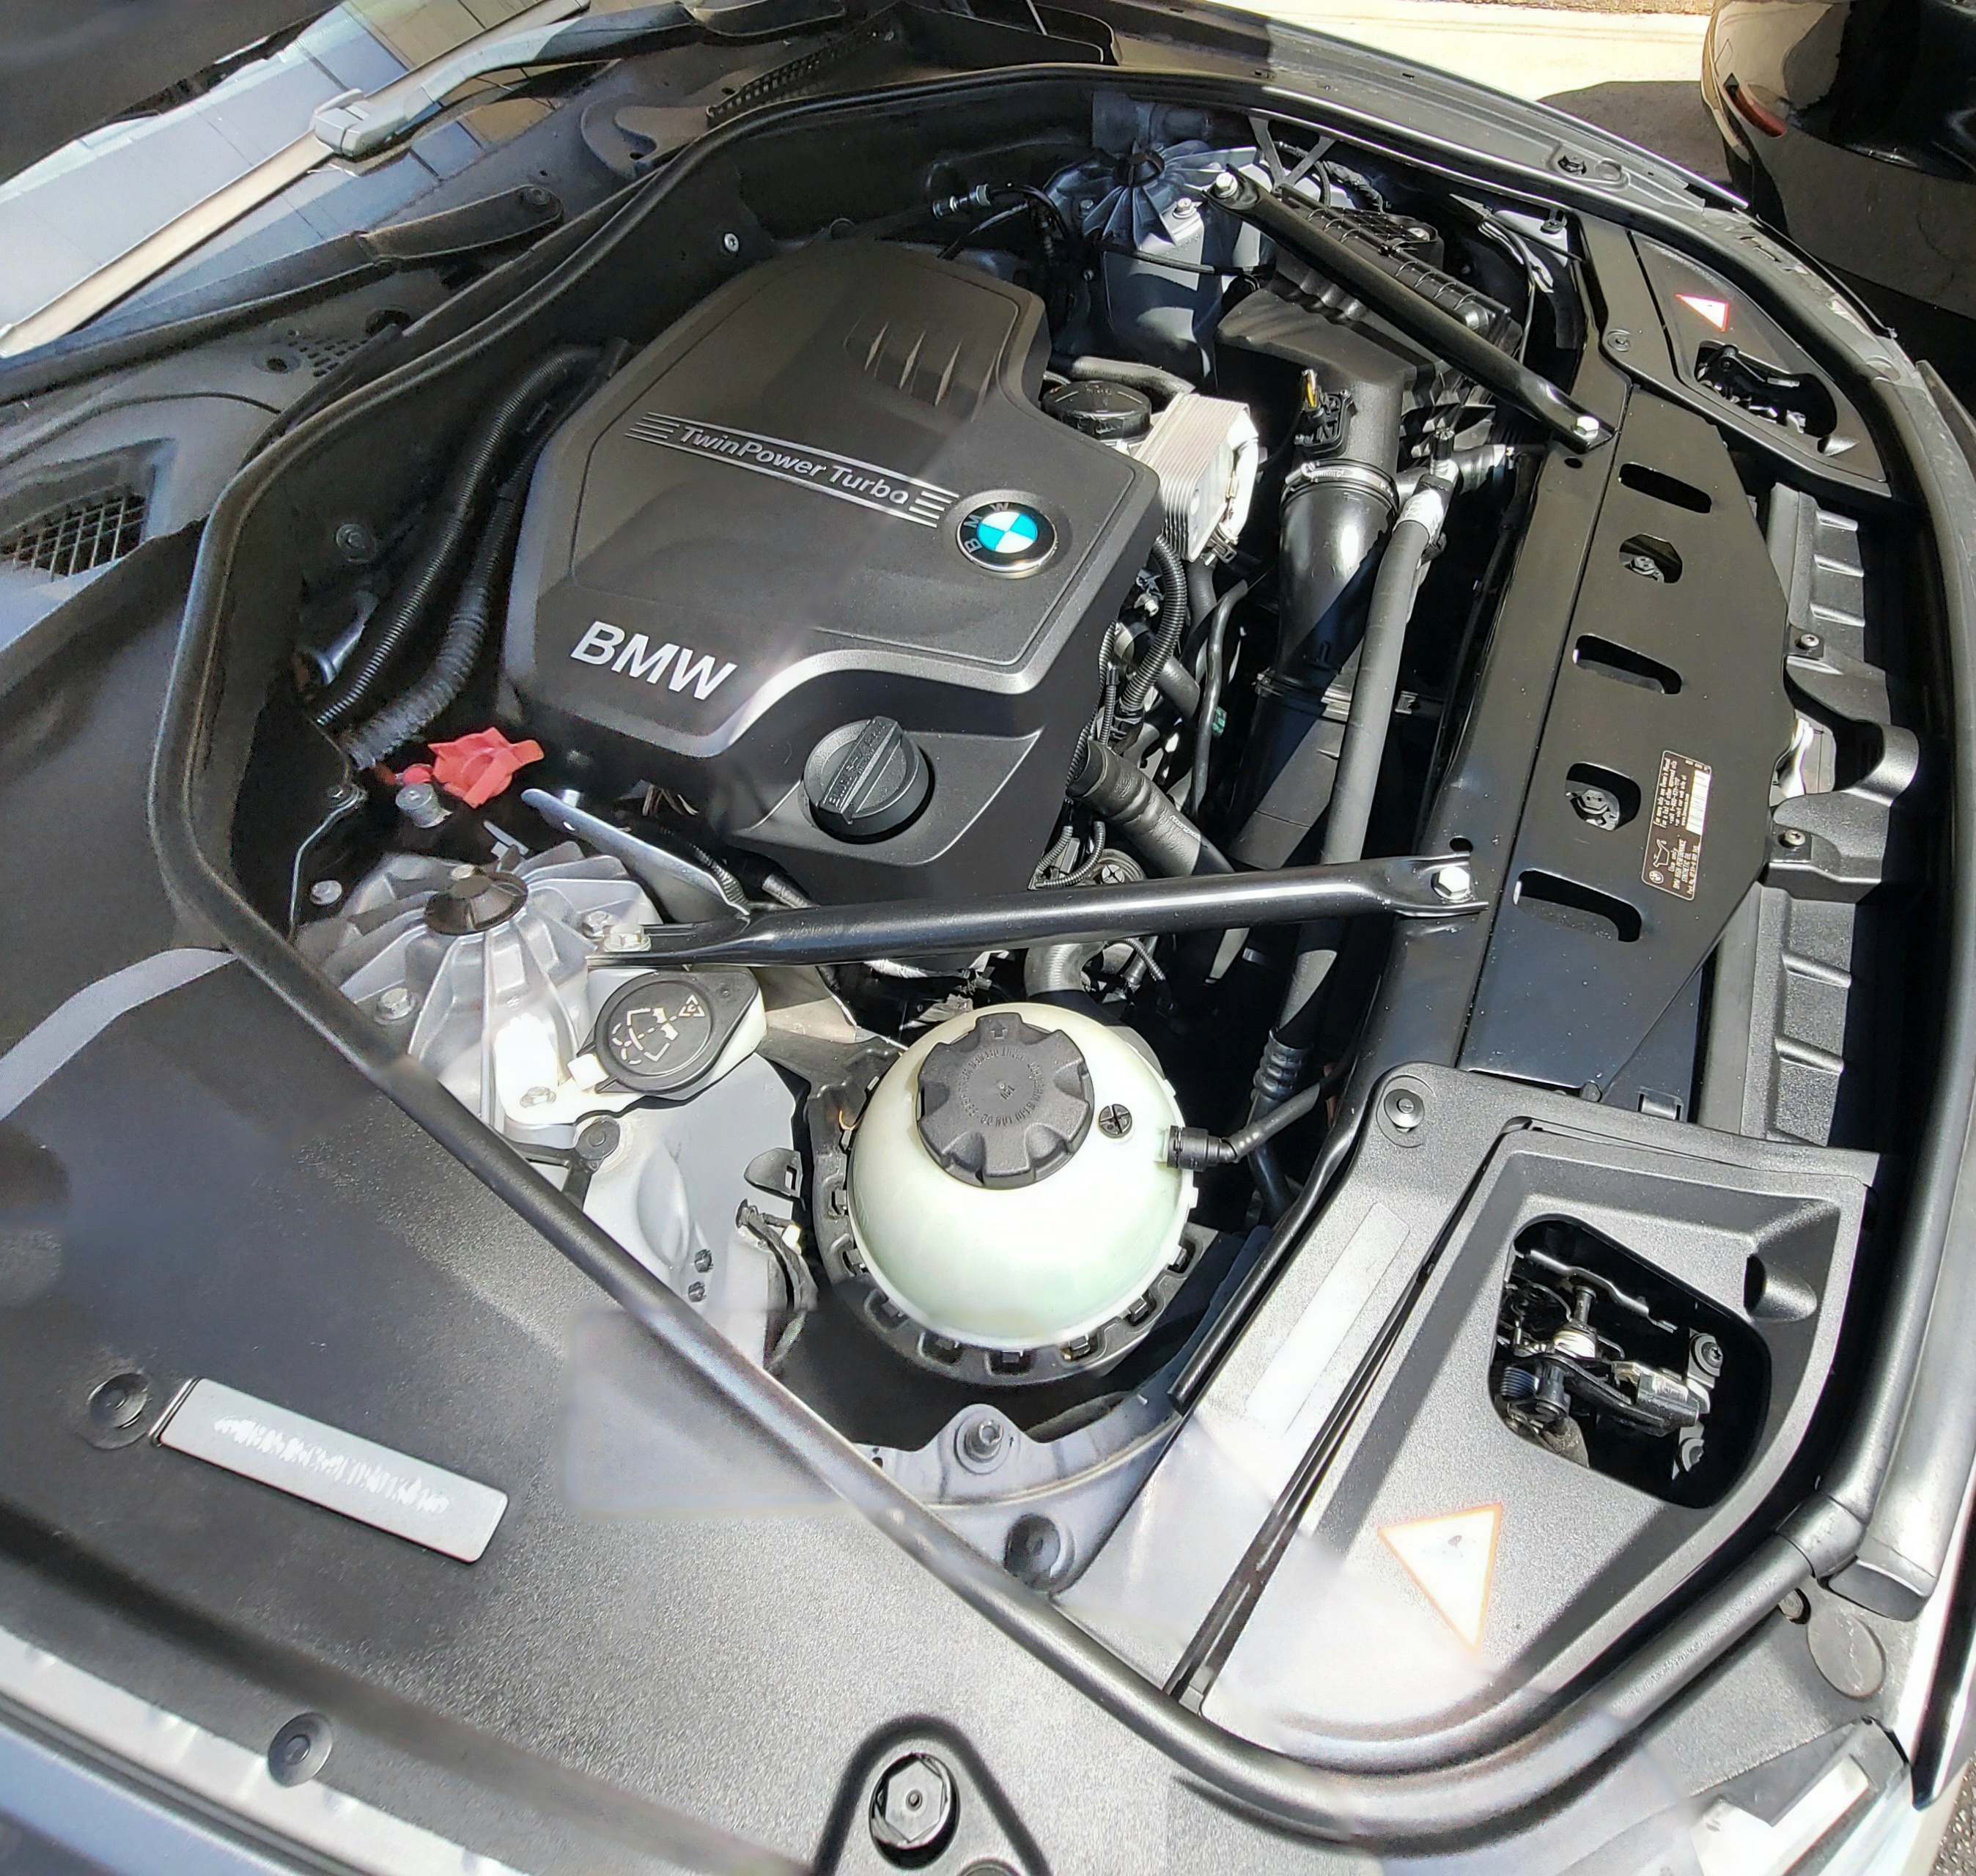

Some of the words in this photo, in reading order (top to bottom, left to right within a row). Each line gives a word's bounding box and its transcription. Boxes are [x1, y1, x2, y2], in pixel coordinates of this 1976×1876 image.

[680, 426, 827, 477] TwinPower
[829, 465, 911, 505] Turbo
[963, 501, 1009, 553] BMW
[570, 621, 738, 701] BMW
